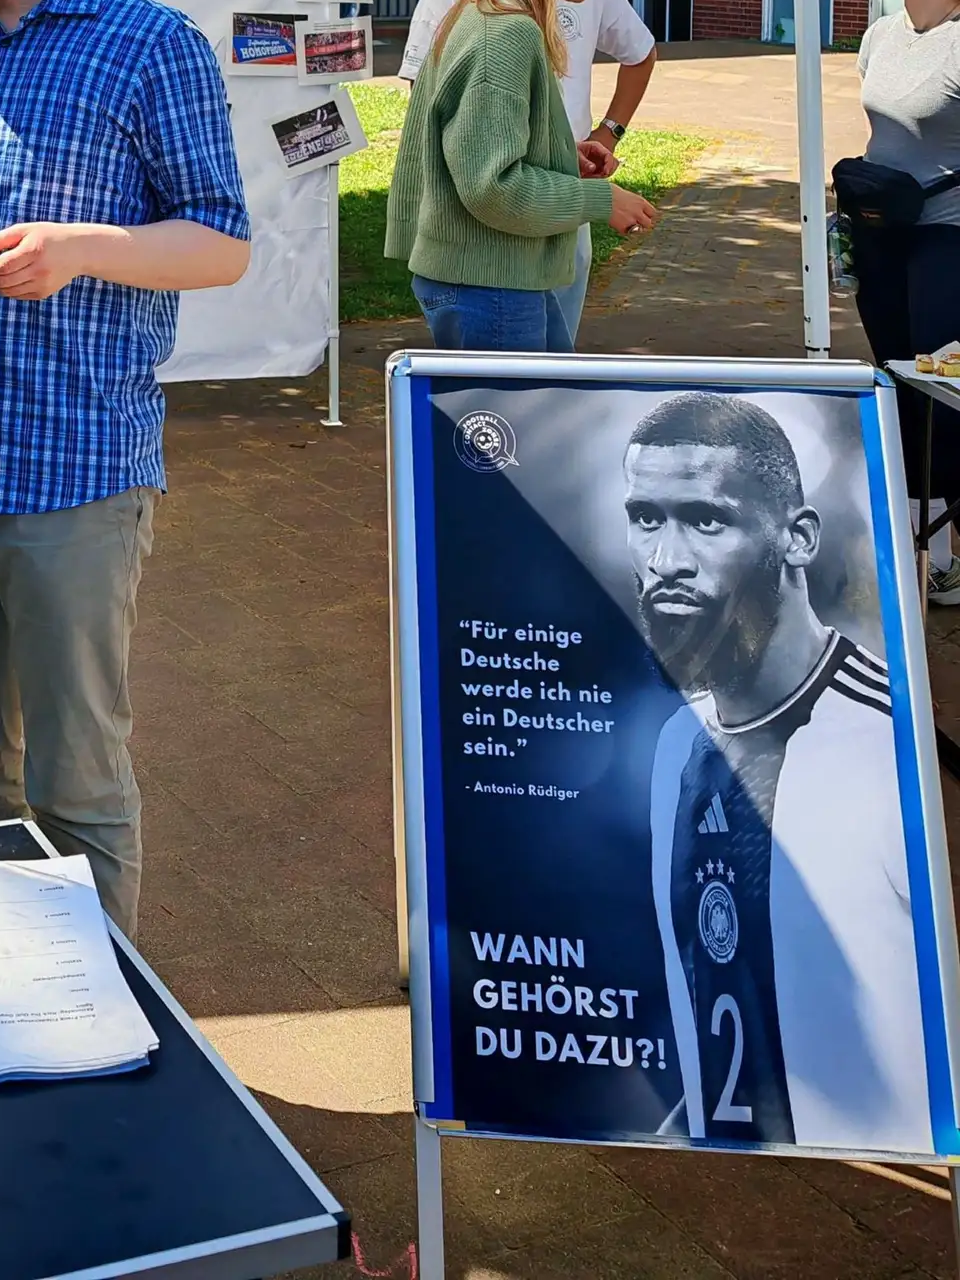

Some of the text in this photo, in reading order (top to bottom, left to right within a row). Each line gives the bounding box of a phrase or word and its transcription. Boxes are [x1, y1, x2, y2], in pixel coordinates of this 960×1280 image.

[514, 623, 583, 649] einige
[460, 648, 560, 671] Deutsche
[461, 679, 613, 704] werde ich nie
[462, 707, 615, 733] ein Deutscher
[474, 781, 525, 796] Antonio
[528, 784, 580, 801] Rüdiger
[470, 931, 586, 968] WANN
[472, 975, 639, 1020] GEHÖRST
[475, 1026, 667, 1070] DU DAZU?!
[710, 993, 753, 1123] 2
